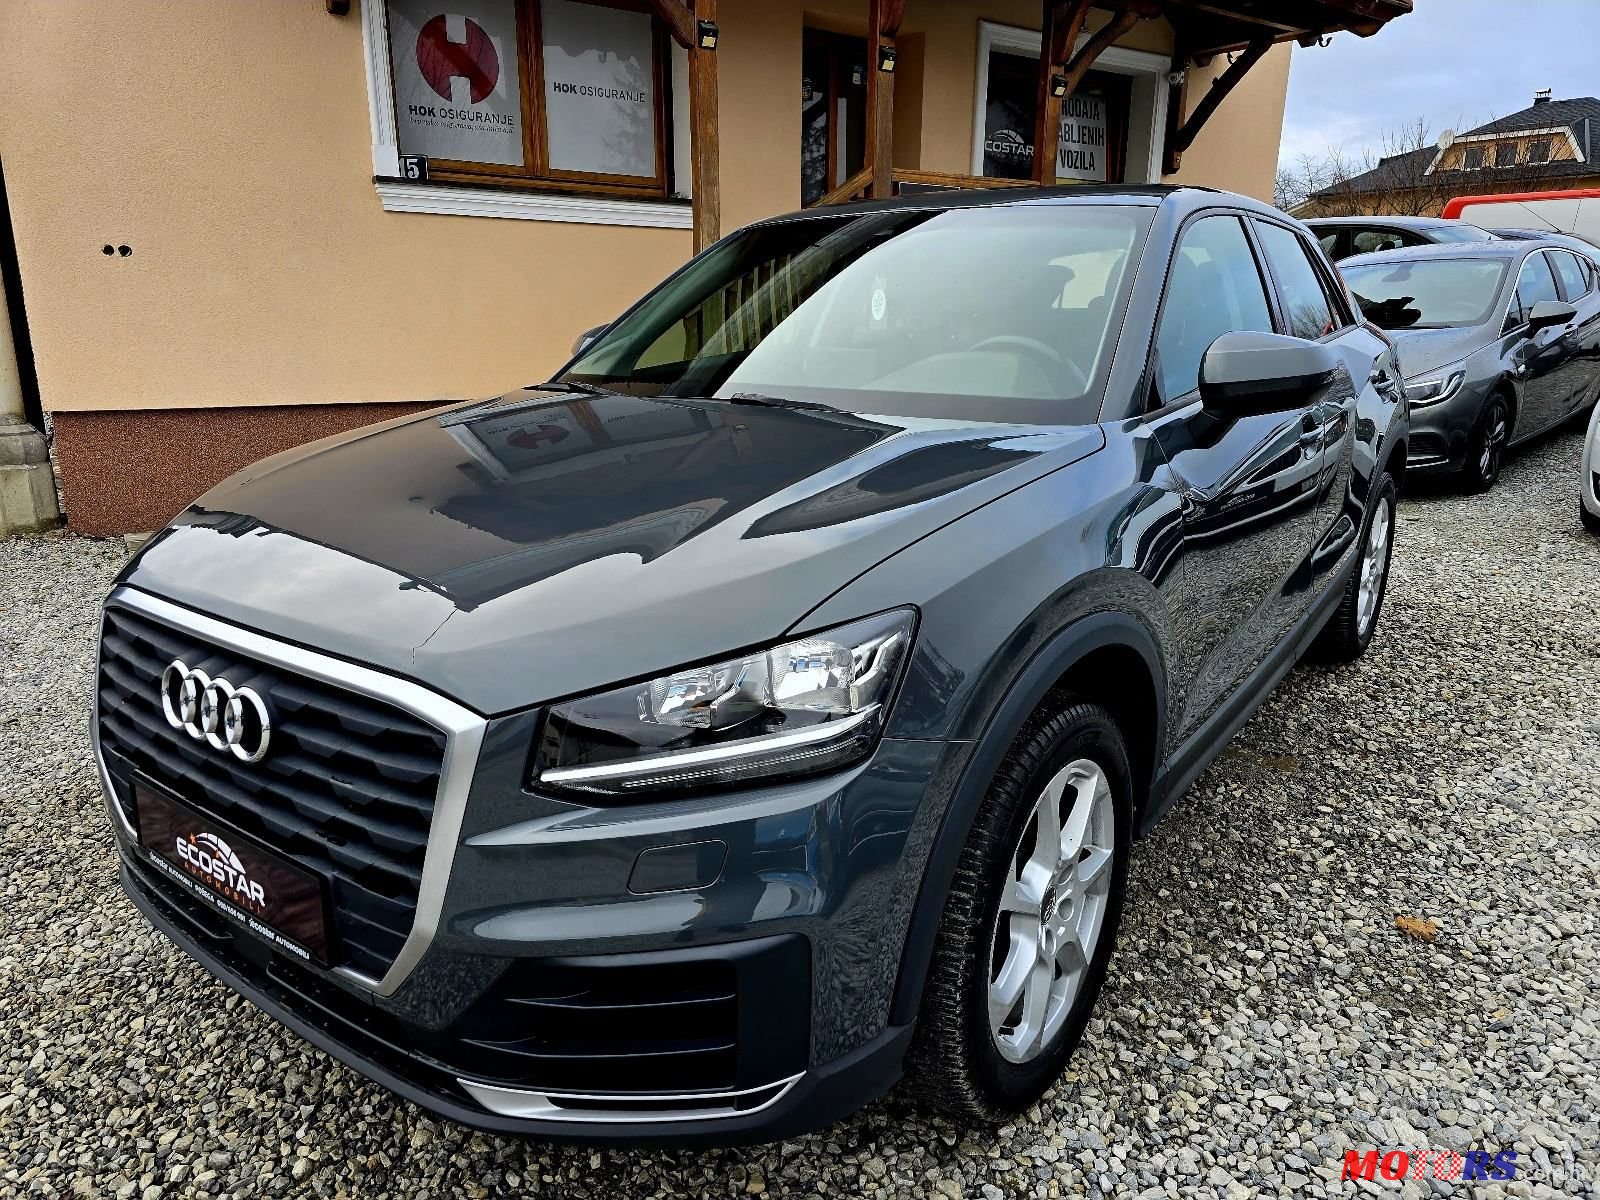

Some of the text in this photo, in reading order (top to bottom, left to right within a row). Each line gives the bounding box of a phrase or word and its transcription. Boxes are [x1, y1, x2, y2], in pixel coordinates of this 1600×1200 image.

[553, 82, 646, 103] HOK OSIGURANJE
[408, 104, 515, 126] HOK OSIGURANJE
[1061, 97, 1100, 121] RODAJA
[1057, 121, 1105, 147] ABLJENIH
[984, 140, 1035, 157] COSTAR
[1059, 148, 1096, 172] VOZILA
[176, 836, 266, 908] ECOSTAR
[184, 861, 262, 915] AUTOMOBILI
